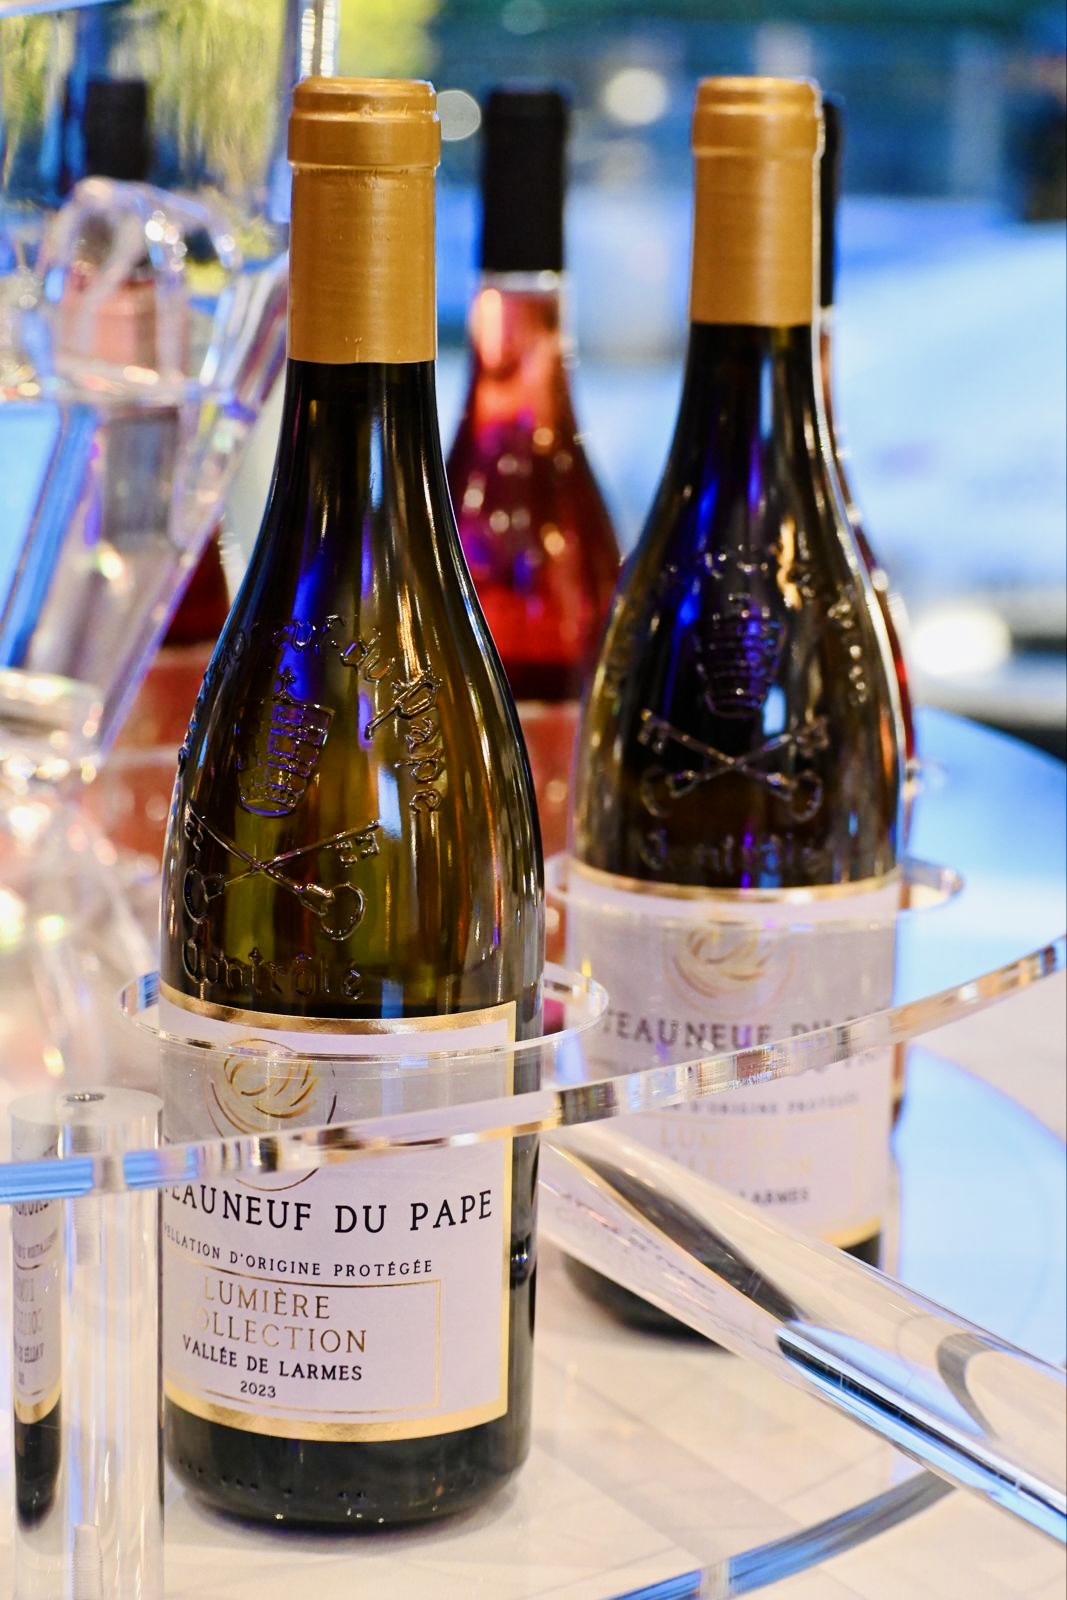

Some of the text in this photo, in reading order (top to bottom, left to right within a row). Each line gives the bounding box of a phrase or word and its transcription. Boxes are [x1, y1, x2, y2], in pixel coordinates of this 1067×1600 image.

[335, 1205, 387, 1234] DU
[410, 1190, 492, 1231] PAPE
[229, 1251, 321, 1276] D'ORIGINE
[334, 1259, 432, 1277] PROTÉGÉE
[204, 1276, 330, 1320] LUMIÈRE
[182, 1334, 363, 1382] VALLÉE DE LARMES
[240, 1380, 277, 1399] 2023
